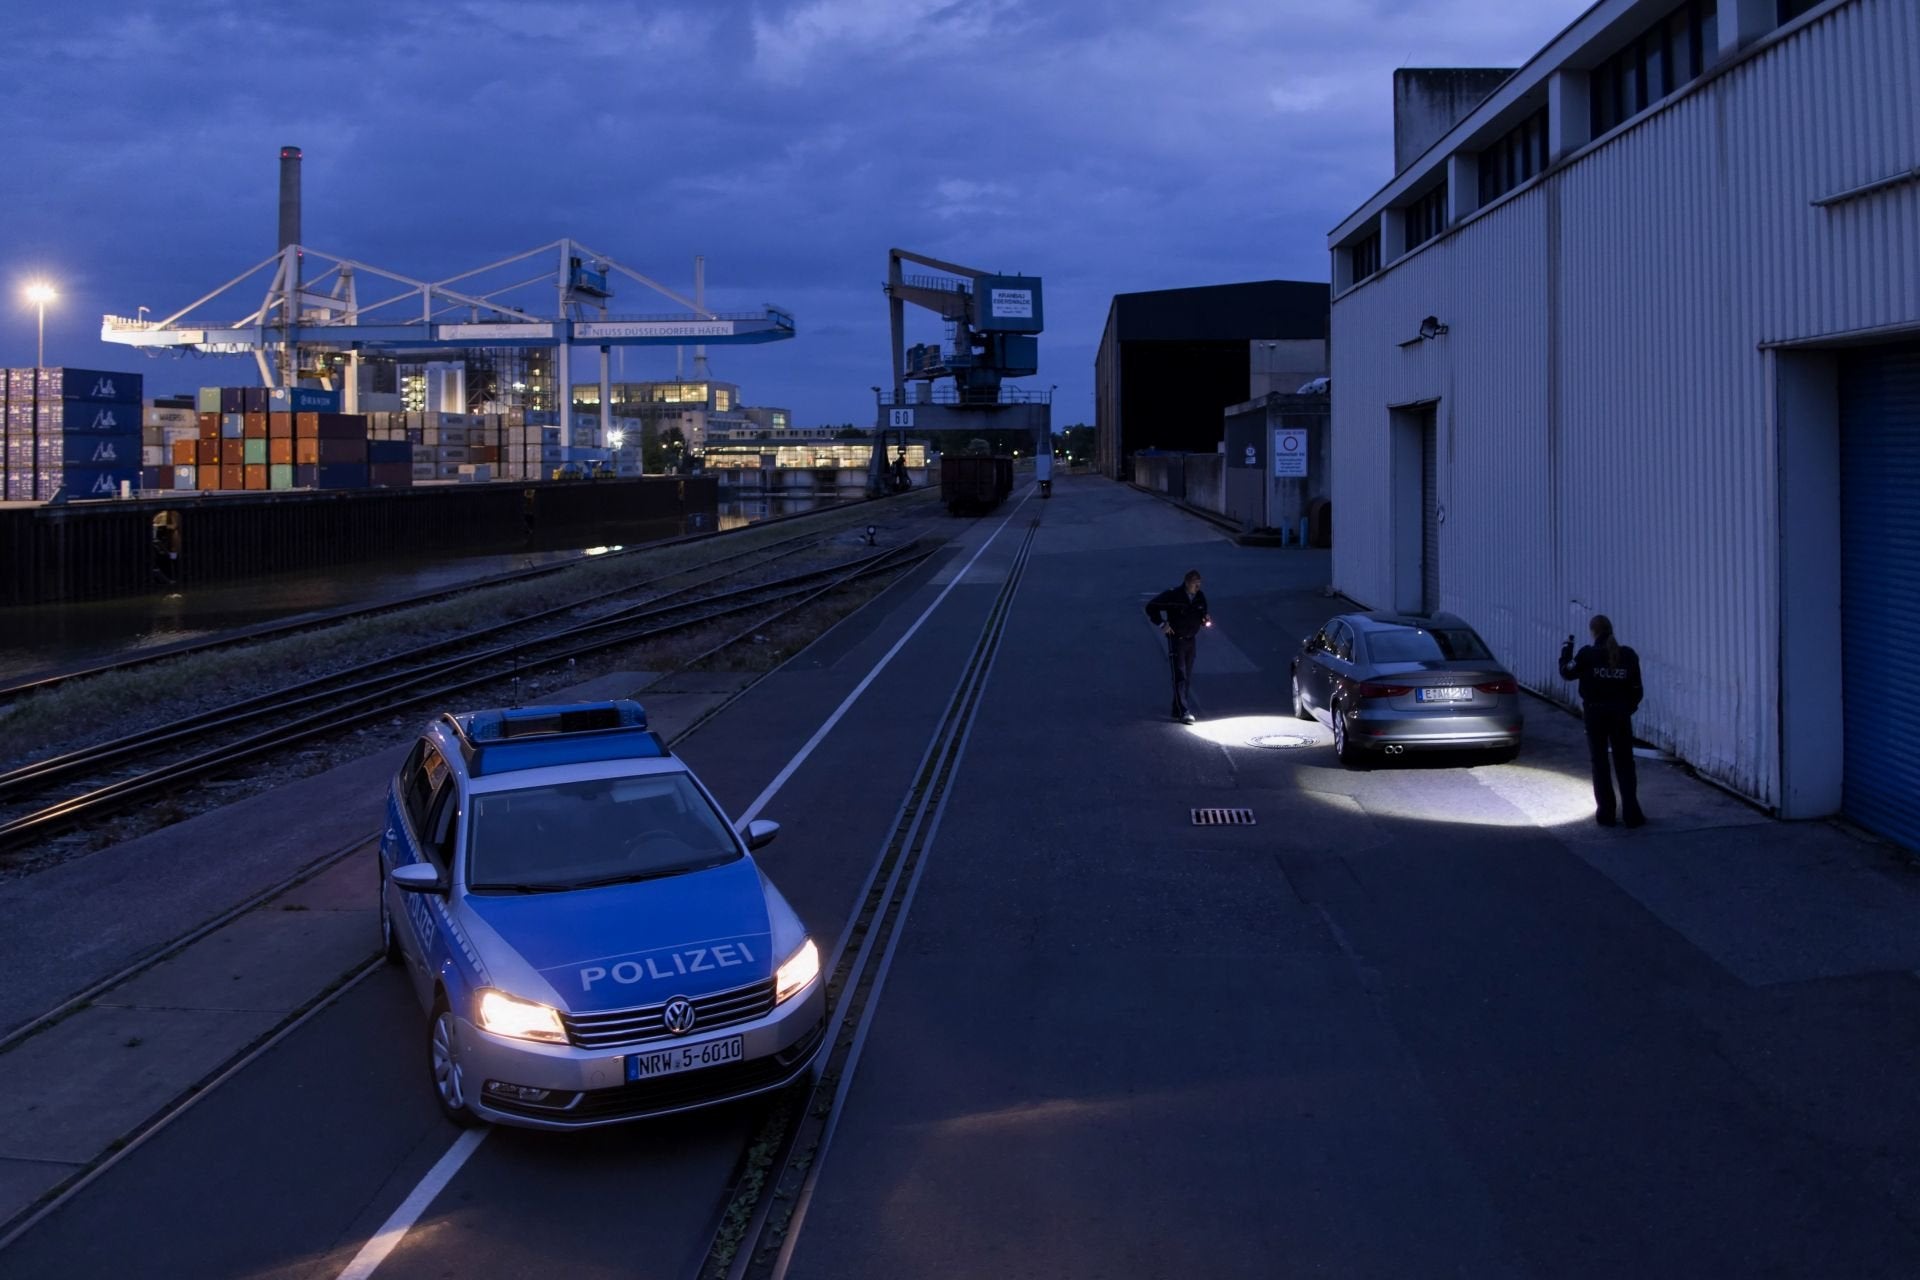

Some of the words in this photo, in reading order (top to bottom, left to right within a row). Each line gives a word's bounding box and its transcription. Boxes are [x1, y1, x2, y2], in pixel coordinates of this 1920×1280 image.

[593, 328, 621, 337] NEUSS
[895, 411, 909, 425] 60
[580, 942, 755, 992] POLIZEI
[639, 1055, 672, 1076] NRW
[683, 1039, 741, 1067] 5-6010
